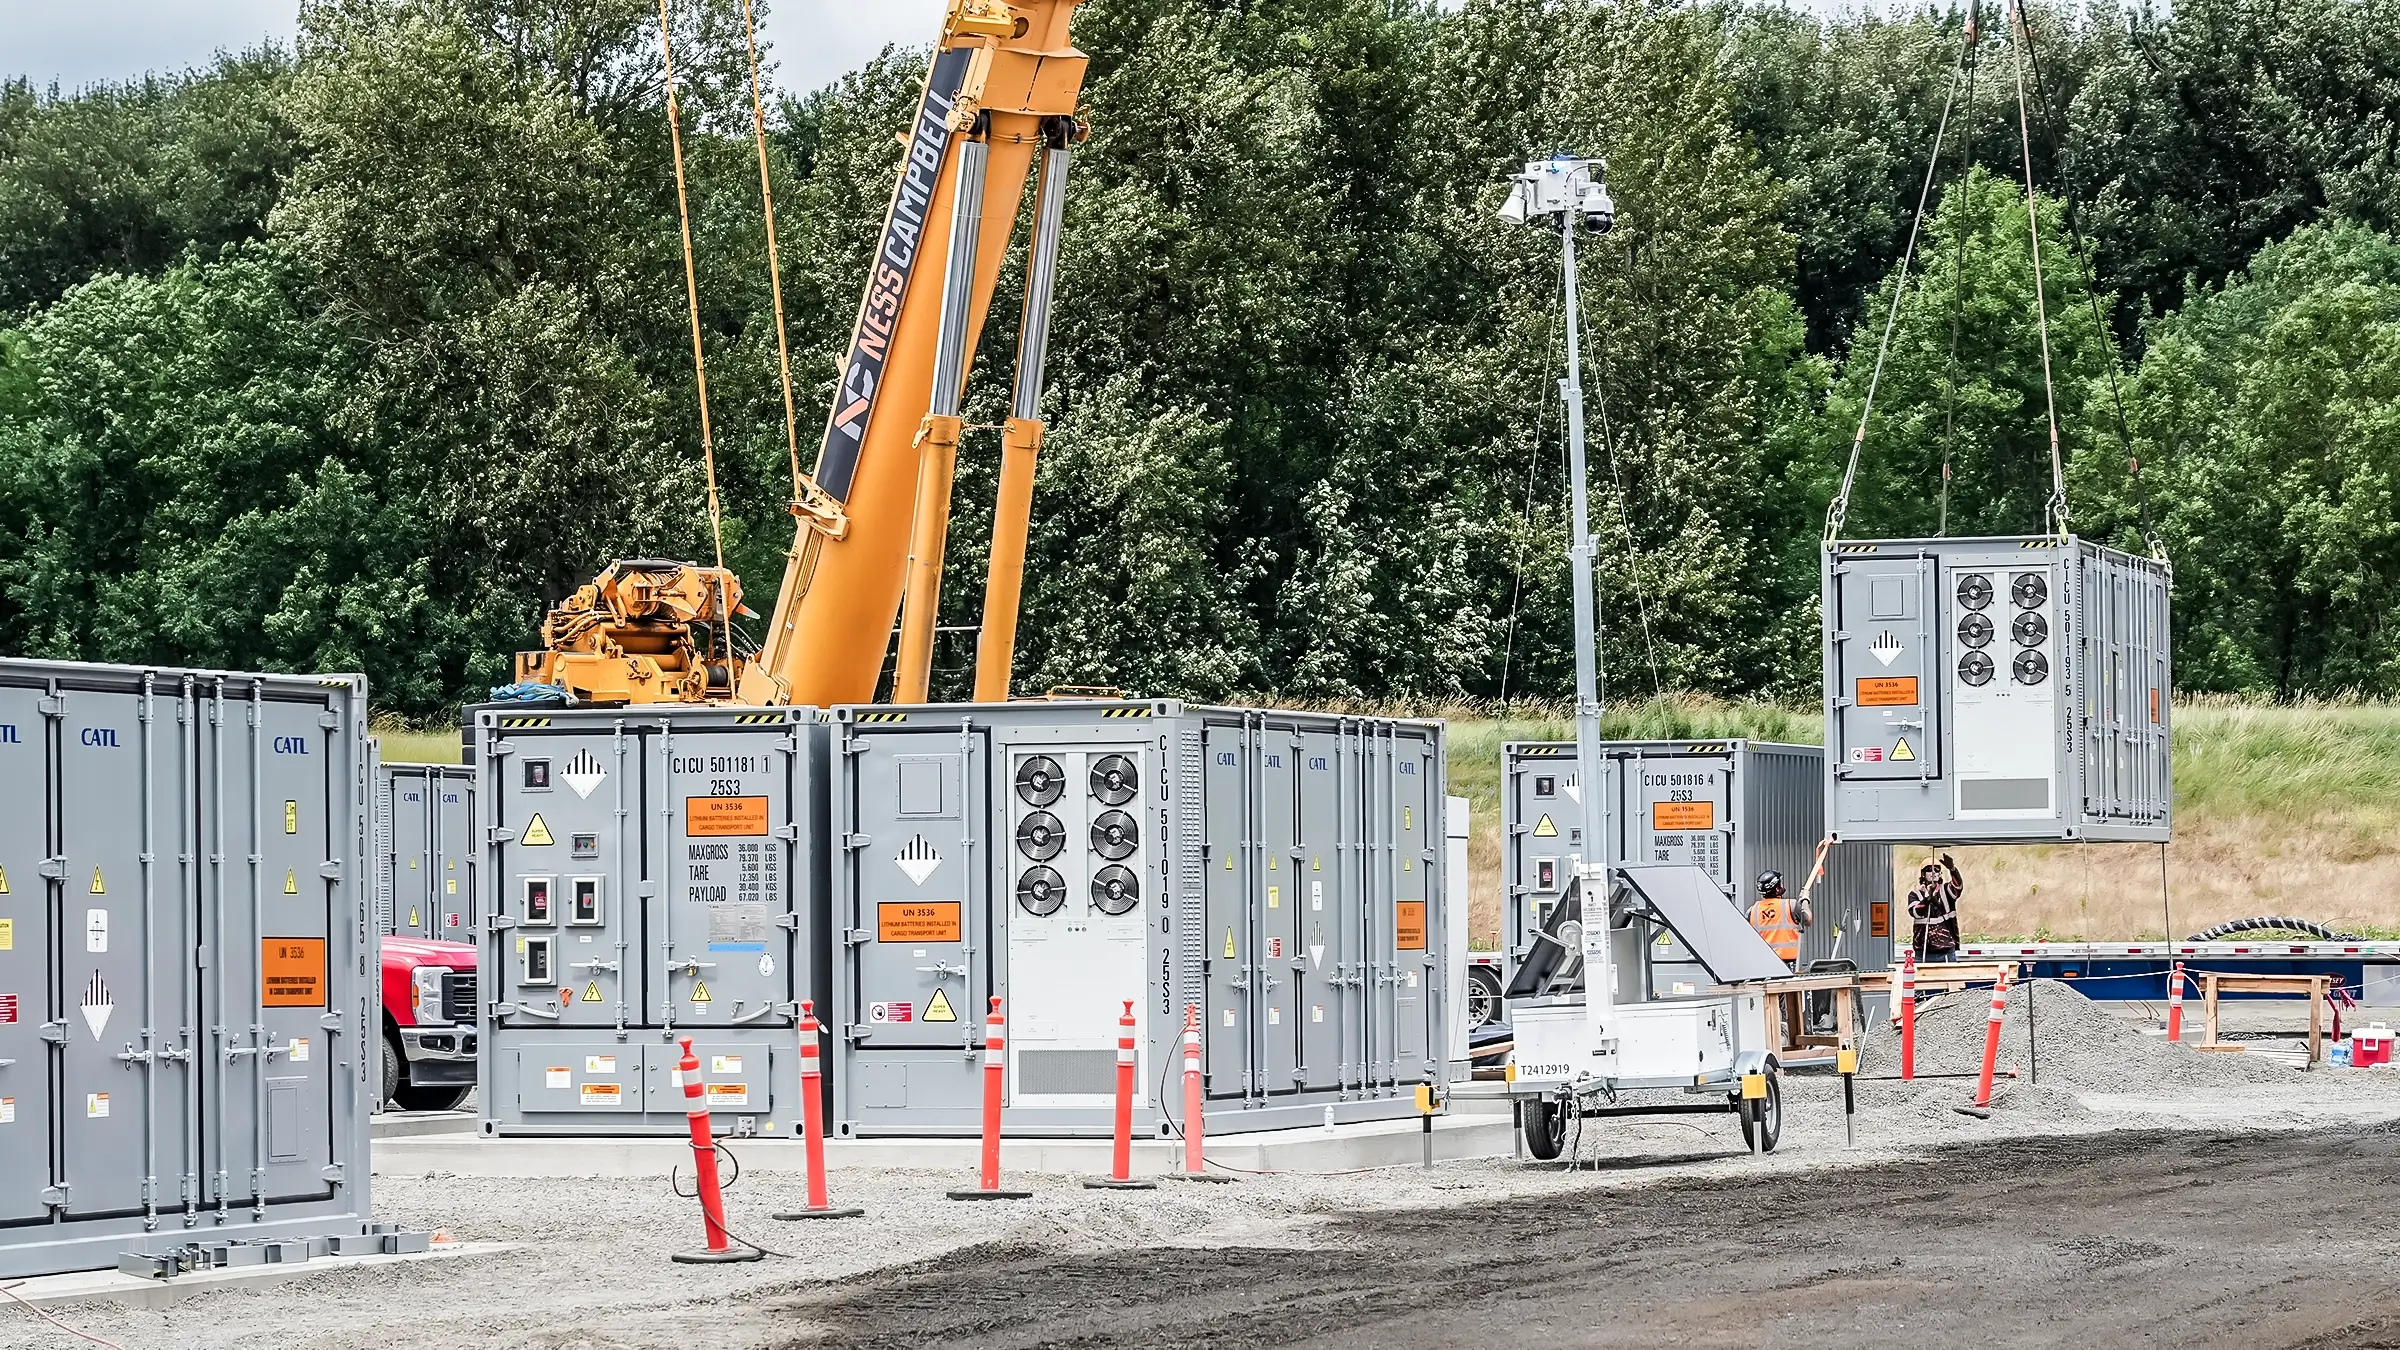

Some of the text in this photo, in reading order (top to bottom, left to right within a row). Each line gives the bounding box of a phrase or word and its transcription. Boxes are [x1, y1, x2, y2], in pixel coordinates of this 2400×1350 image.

[858, 262, 904, 362] NESS
[884, 89, 954, 269] CAMPBELL
[2065, 685, 2071, 696] 5
[0, 724, 21, 743] TL
[81, 728, 120, 747] CATL
[274, 736, 309, 754] CATL
[673, 757, 703, 773] CICU
[711, 757, 754, 773] 501181
[1217, 753, 1236, 766] CATL
[1309, 758, 1328, 770] CATL
[1160, 735, 1168, 801] CICU
[1400, 762, 1415, 775] CATL
[1644, 775, 1666, 786] CICU
[1671, 774, 1704, 786] 501816
[711, 780, 741, 795] 25S3
[403, 793, 420, 802] CATL
[443, 794, 459, 804] CATL
[1671, 790, 1693, 801] 25S3
[725, 803, 743, 811] 3536
[1654, 835, 1683, 846] MAXGROSS
[688, 843, 777, 860] MAXGROSS 36.000 KGS
[738, 854, 777, 862] 79.370 LBS
[1654, 850, 1670, 861] TARE
[1161, 809, 1169, 908] 501019
[689, 863, 777, 881] TARE 5.600 KGS
[739, 873, 777, 881] 12.350 LBS
[689, 883, 777, 902] PAYLOAD 30.400 KGS
[739, 893, 778, 901] 67.020 LBS
[1162, 917, 1169, 933] 0
[1521, 1064, 1570, 1075] T2412919
